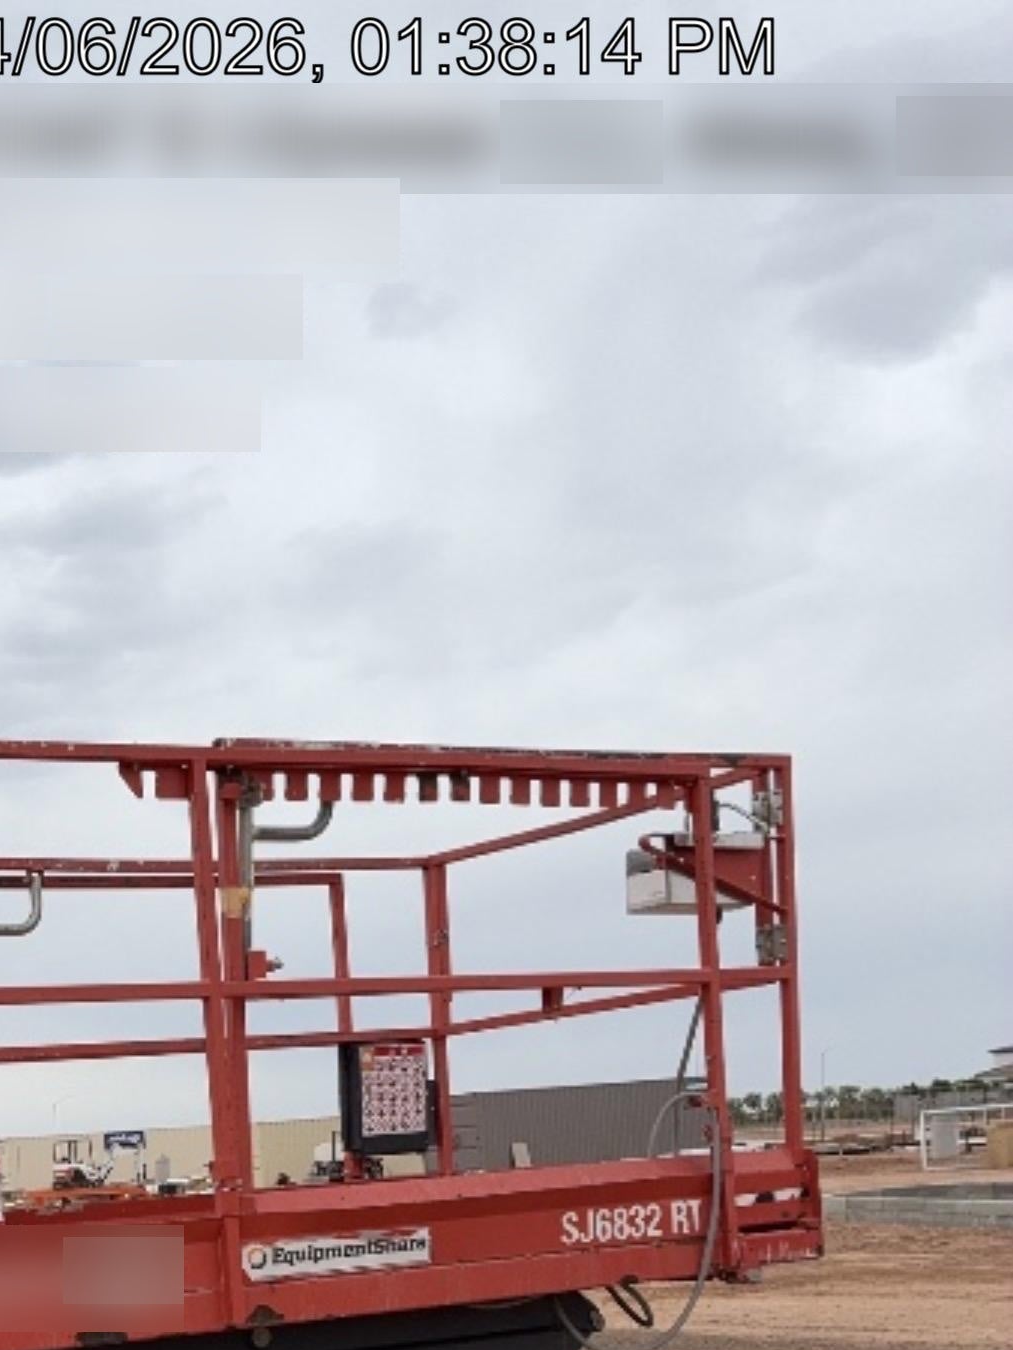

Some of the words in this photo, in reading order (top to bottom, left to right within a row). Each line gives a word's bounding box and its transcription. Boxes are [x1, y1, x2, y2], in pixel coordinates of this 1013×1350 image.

[560, 1202, 663, 1244] SJ6832
[671, 1198, 703, 1235] RT
[271, 1237, 426, 1266] EquipmentShare
